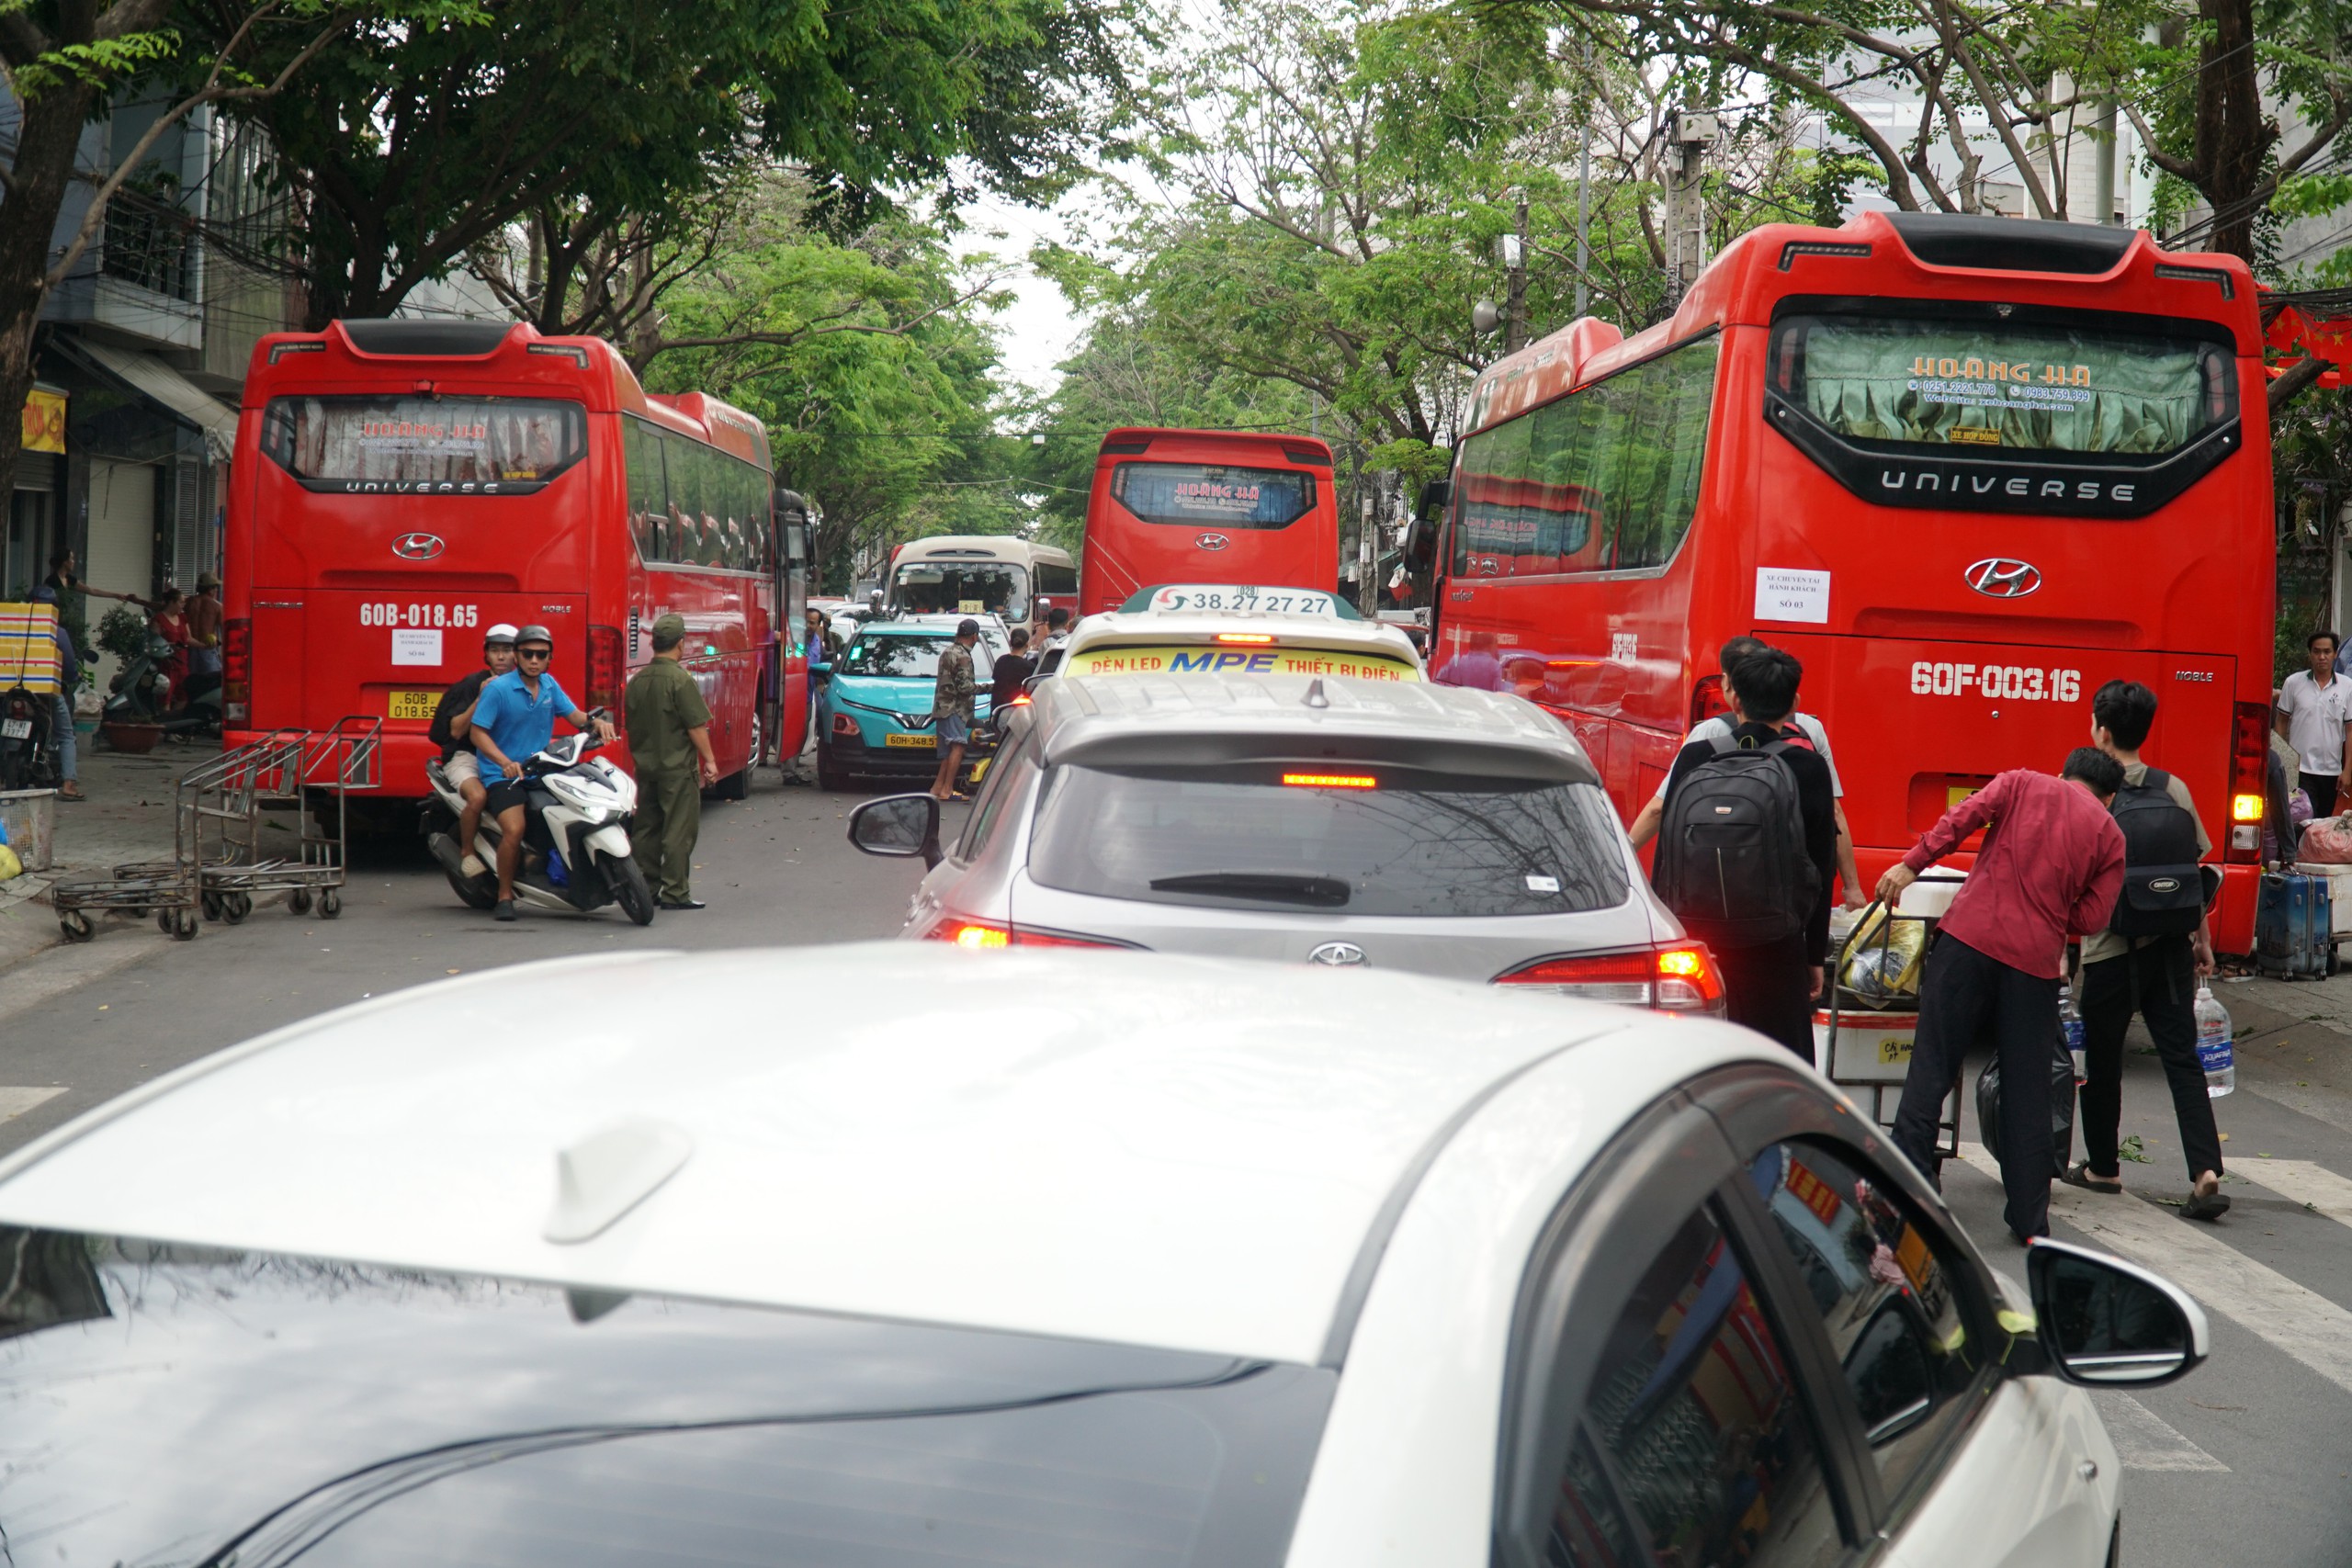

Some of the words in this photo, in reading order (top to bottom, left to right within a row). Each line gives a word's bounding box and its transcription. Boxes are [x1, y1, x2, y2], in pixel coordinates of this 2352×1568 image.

[1924, 393, 1976, 405] Website:
[1979, 399, 2075, 412] xehoangha.com
[346, 482, 498, 493] UNIVERSE
[1882, 471, 2135, 502] UNIVERSE
[542, 604, 571, 614] NOBLE
[1193, 593, 1259, 610] 38.27
[1266, 596, 1293, 612] 27
[1300, 598, 1329, 614] 27
[360, 603, 478, 627] 60B-018.65
[1130, 657, 1161, 671] LED
[1168, 652, 1279, 673] MPE
[1285, 657, 1334, 675] THIẾT
[1911, 661, 2081, 702] 60F-003.16
[2176, 671, 2213, 682] NOBLE
[405, 694, 427, 705] 60B
[394, 705, 437, 717] 018.65
